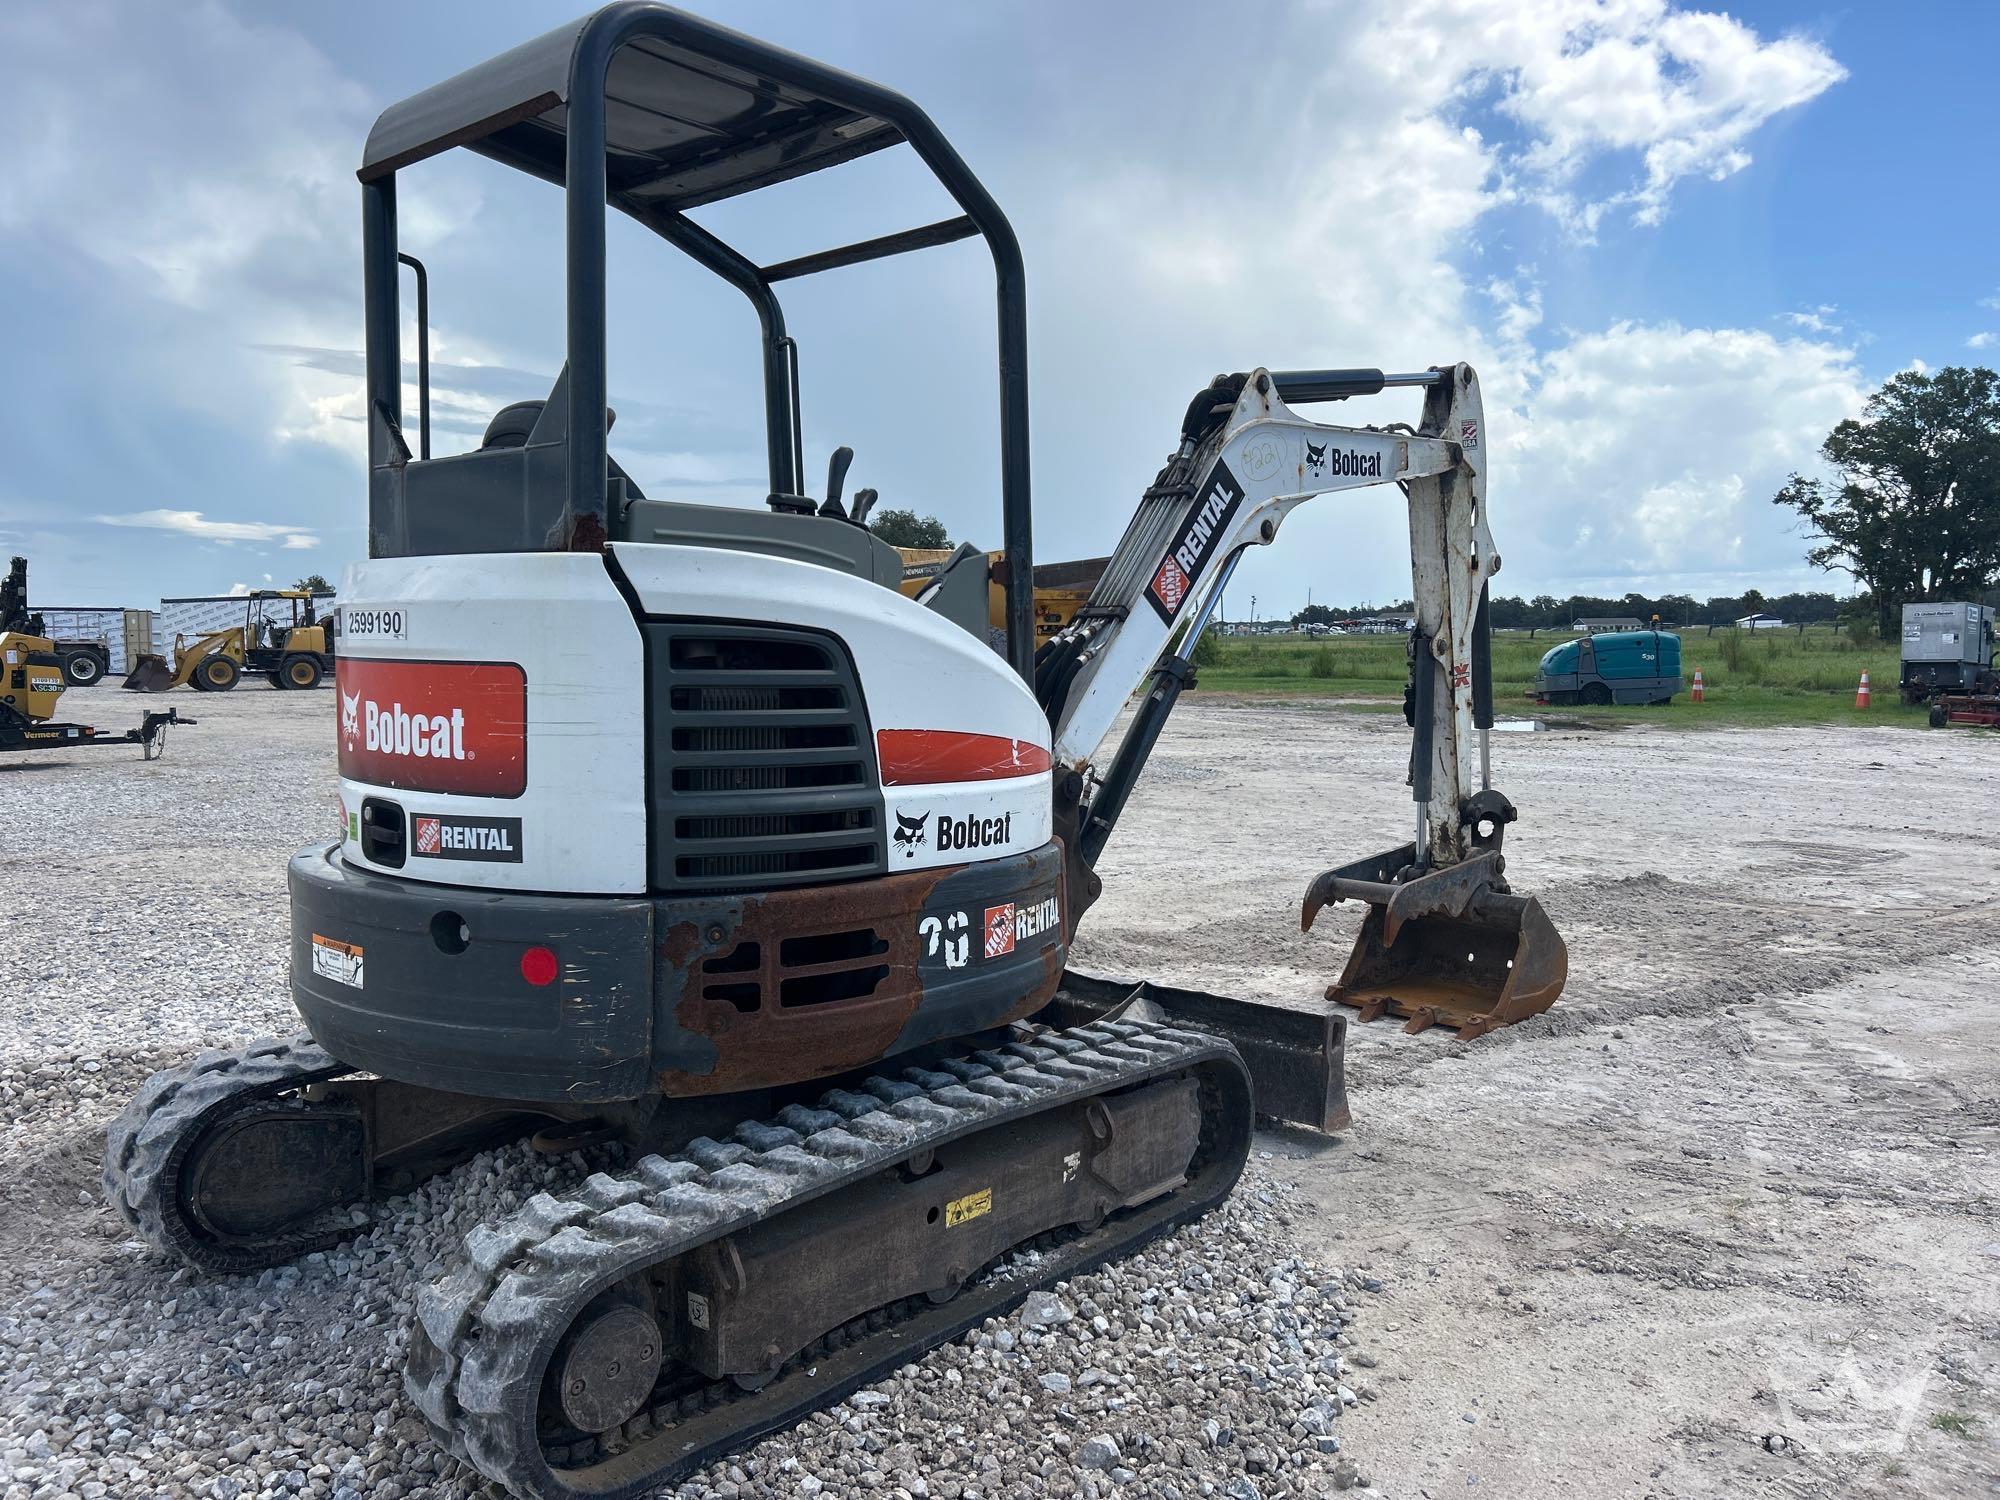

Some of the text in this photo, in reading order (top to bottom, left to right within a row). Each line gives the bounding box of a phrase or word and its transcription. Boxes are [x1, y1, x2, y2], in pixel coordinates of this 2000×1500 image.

[1463, 439, 1476, 447] USA
[1332, 448, 1381, 477] Bobcat
[1175, 482, 1234, 574] RENTAL
[1165, 560, 1177, 609] HOME
[349, 611, 402, 634] 2599190
[24, 731, 60, 739] Vermeer
[365, 700, 465, 760] Bobcat
[417, 819, 440, 852] HOME
[441, 825, 514, 851] RENTAL
[937, 811, 1011, 852] Bobcat
[1016, 897, 1060, 941] RENTAL
